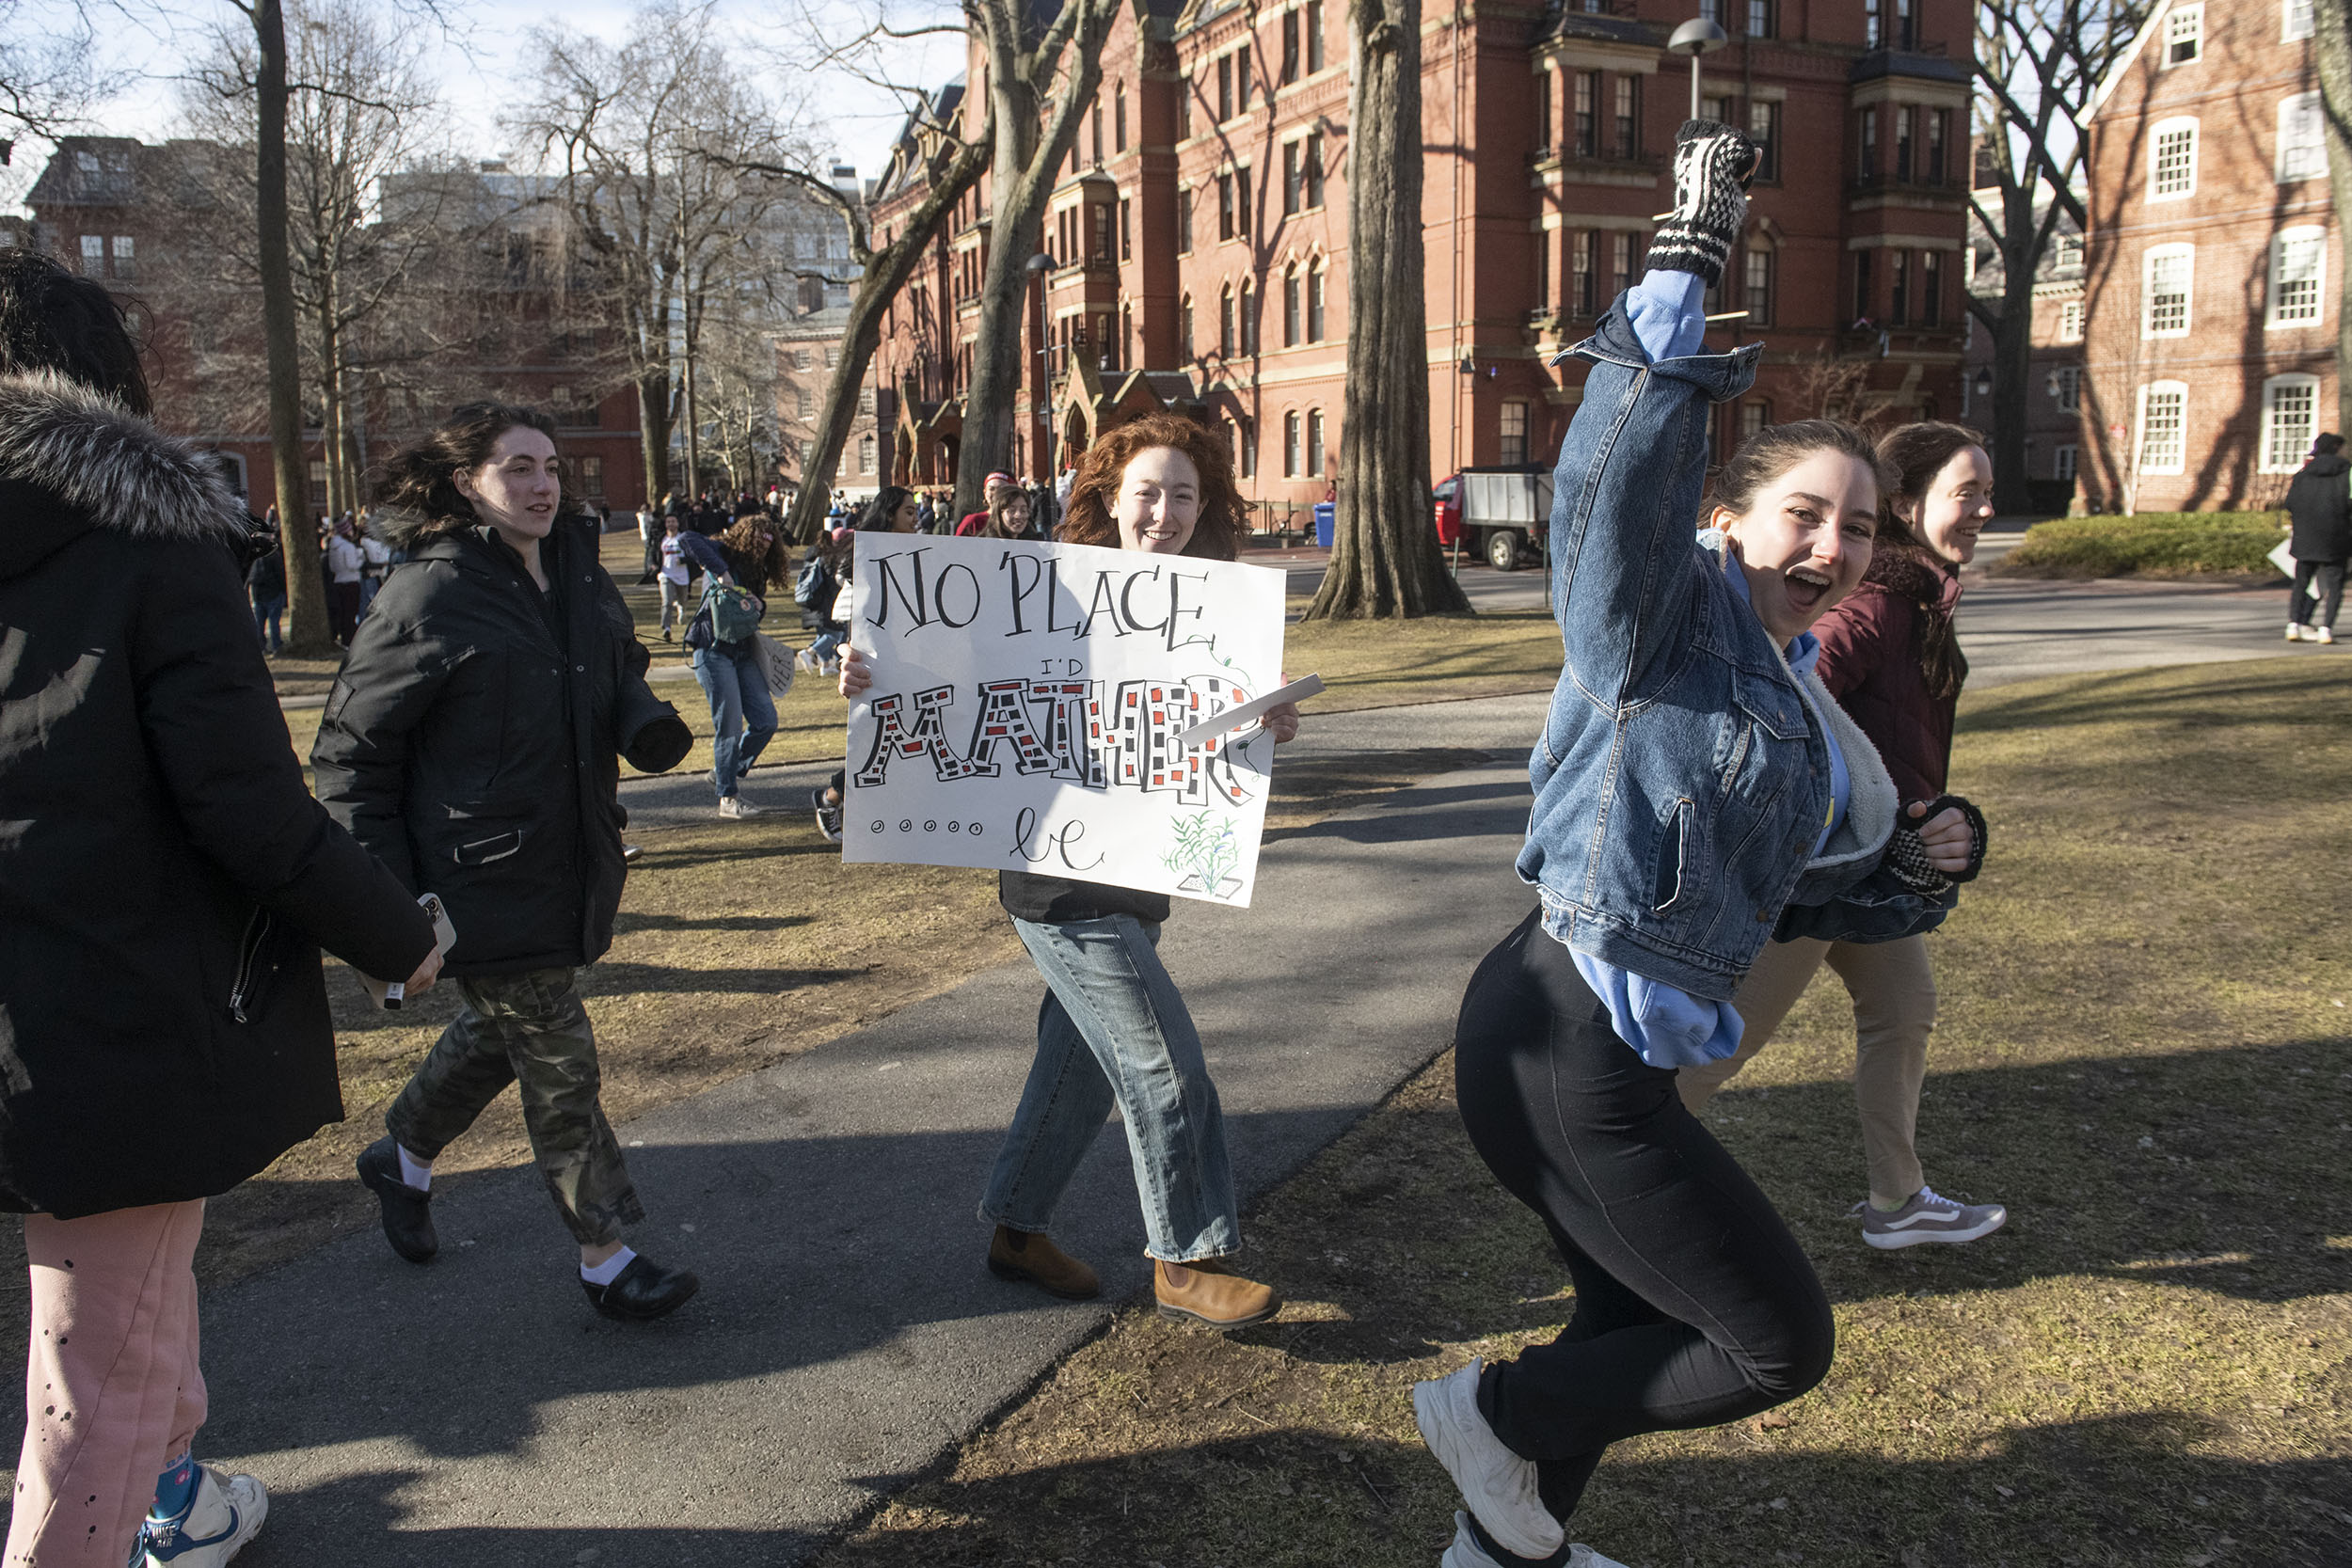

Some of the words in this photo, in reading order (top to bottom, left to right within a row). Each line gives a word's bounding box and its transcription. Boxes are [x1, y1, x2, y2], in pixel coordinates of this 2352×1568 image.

[866, 546, 980, 638] NO
[999, 549, 1216, 651] PLACE
[1041, 658, 1084, 677] I'D
[853, 676, 1260, 807] MATHER
[1009, 806, 1104, 870] be
